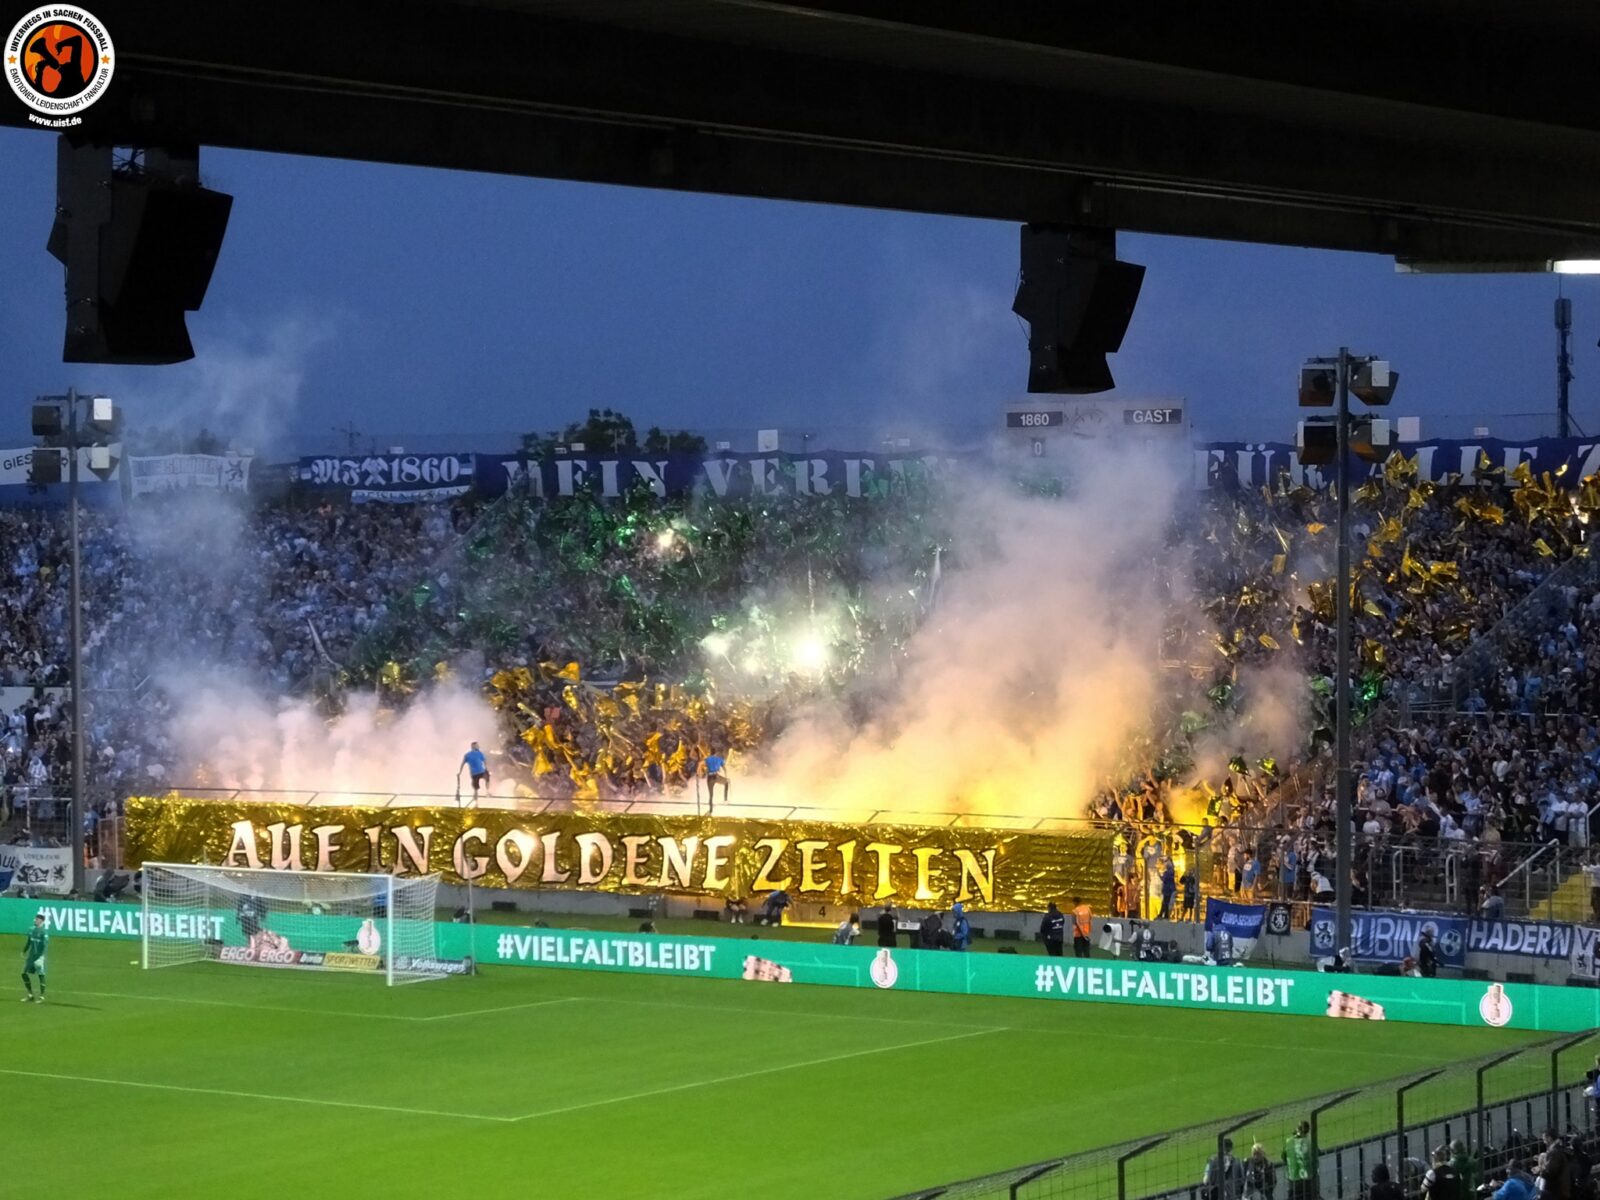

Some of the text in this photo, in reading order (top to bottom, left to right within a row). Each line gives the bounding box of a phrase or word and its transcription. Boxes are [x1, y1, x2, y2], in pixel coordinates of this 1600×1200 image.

[1020, 413, 1049, 426] 1860
[1132, 409, 1172, 423] GAST
[1034, 441, 1042, 455] 0
[390, 456, 460, 484] 1860
[220, 820, 997, 903] AUF IN GOLDENE ZEITEN
[818, 905, 826, 918] 4
[1468, 920, 1571, 956] HADERN
[220, 946, 256, 961] ERGO
[259, 950, 295, 963] ERGO
[496, 933, 716, 972] #VIELFALTBLEIBT
[1035, 964, 1294, 1008] #VIELFALTBLEIBT
